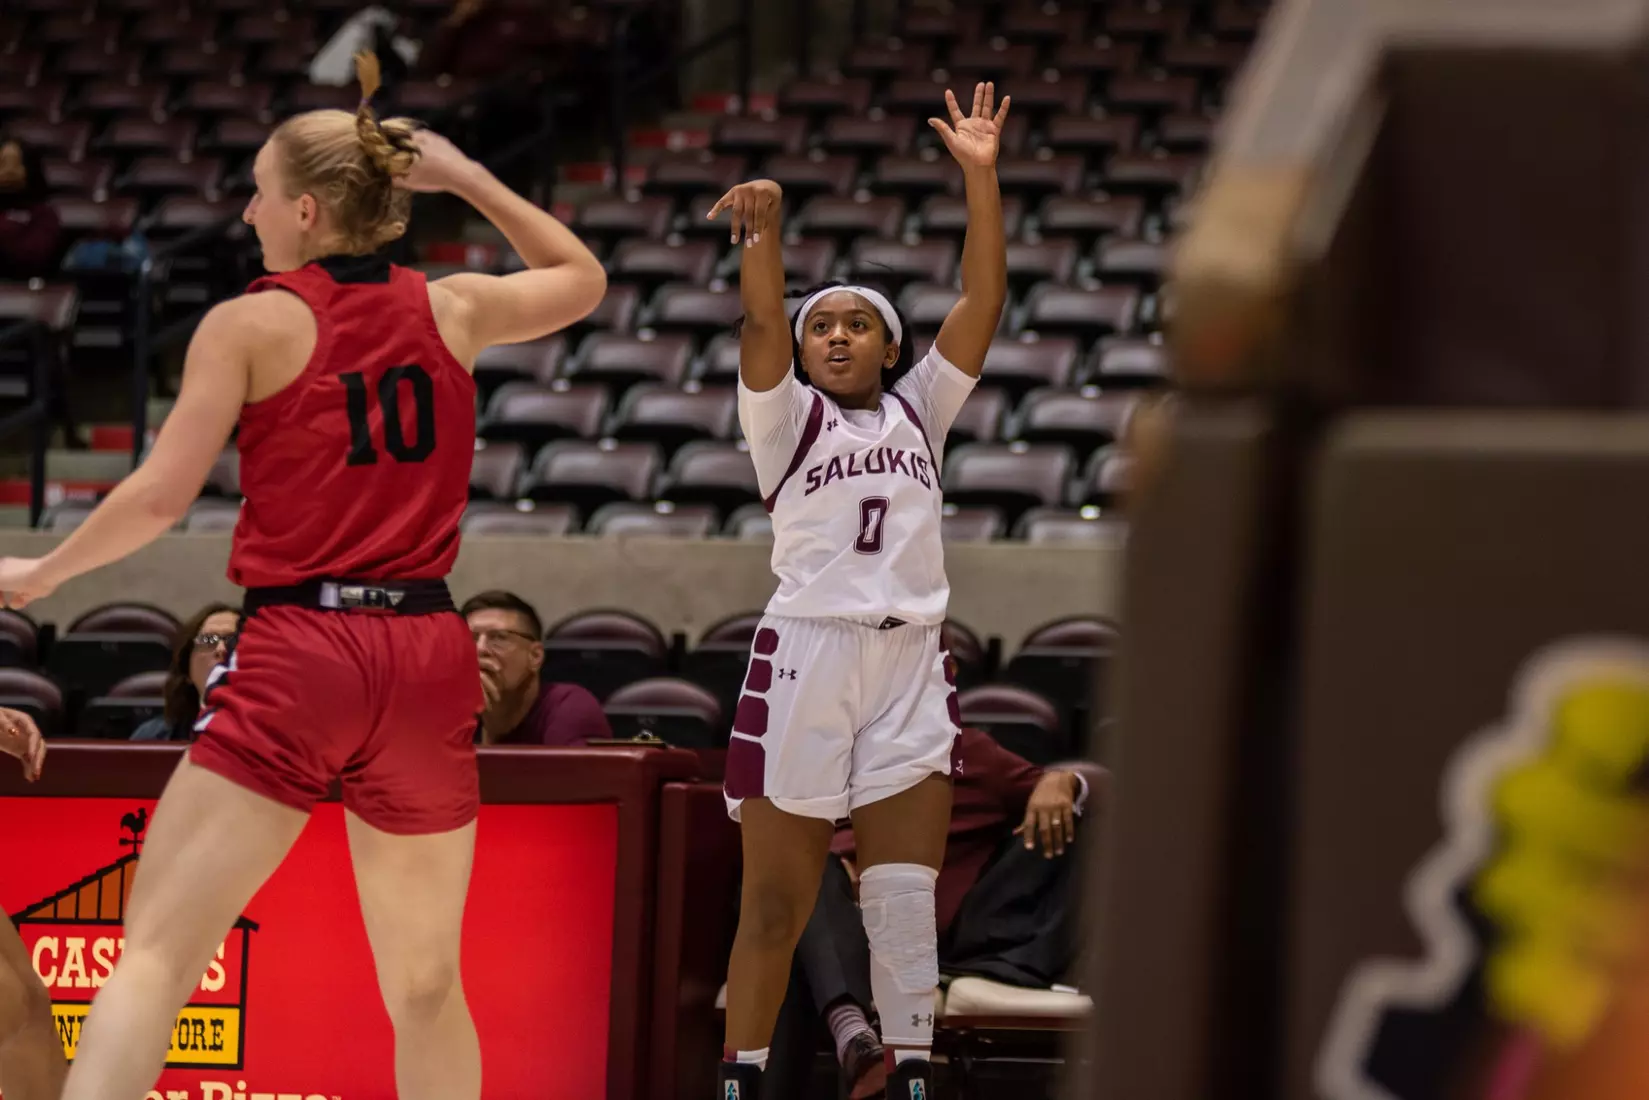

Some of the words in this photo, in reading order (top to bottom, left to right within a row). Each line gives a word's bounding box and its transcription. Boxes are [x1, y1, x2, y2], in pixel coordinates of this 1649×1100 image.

[338, 364, 436, 467] 10
[804, 446, 932, 497] SALUKIS
[853, 495, 890, 555] 0
[32, 936, 226, 992] CASS
